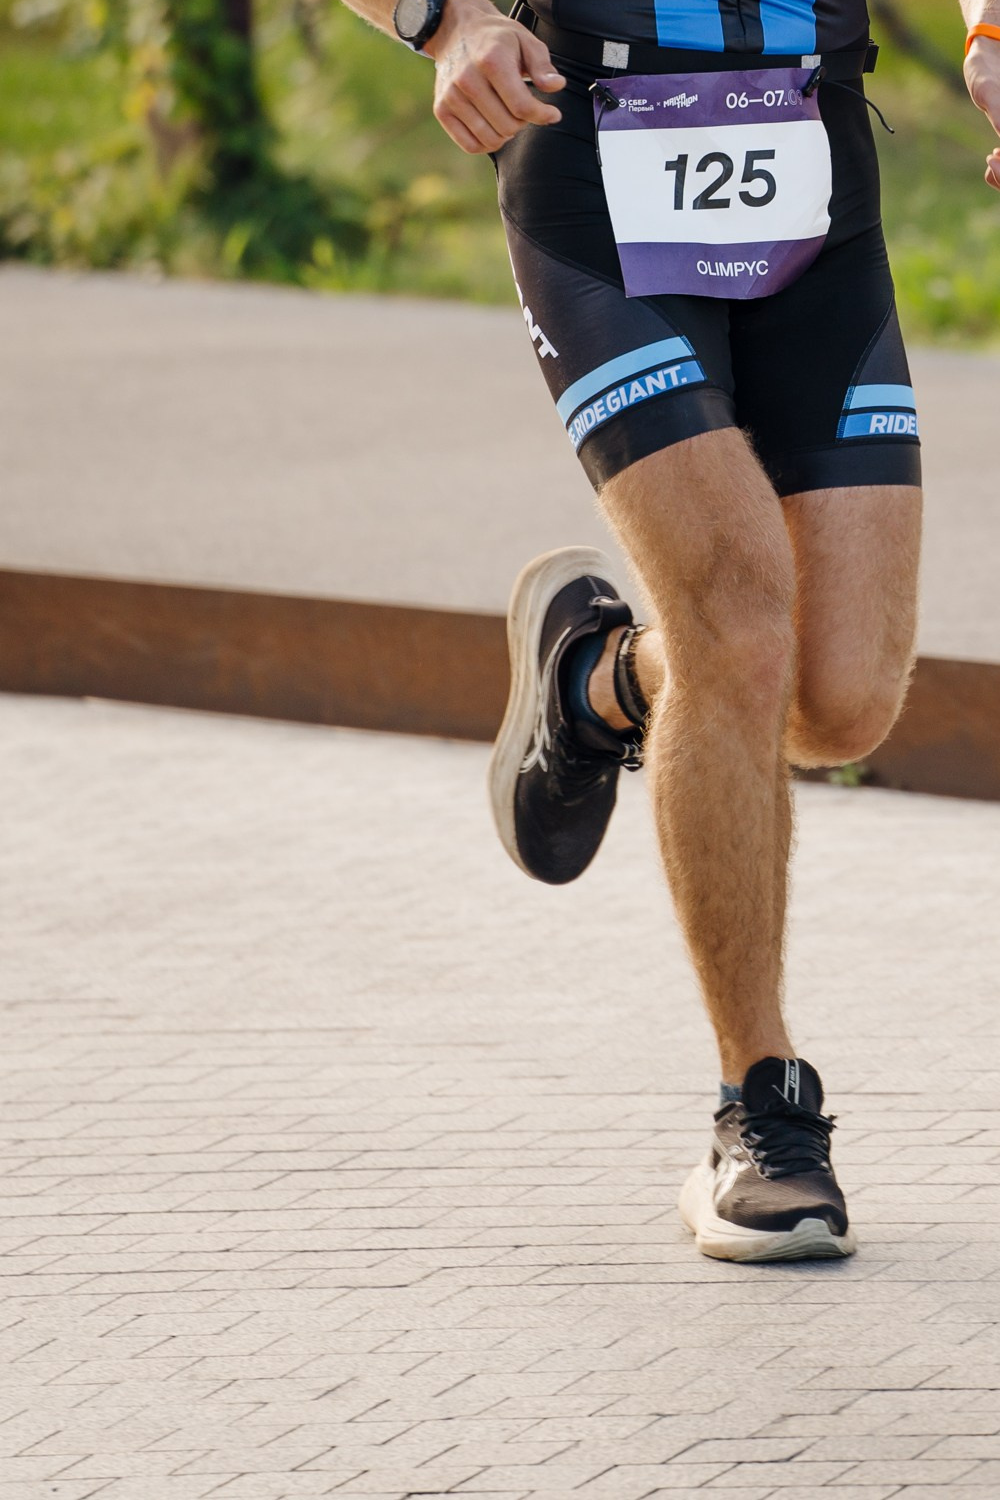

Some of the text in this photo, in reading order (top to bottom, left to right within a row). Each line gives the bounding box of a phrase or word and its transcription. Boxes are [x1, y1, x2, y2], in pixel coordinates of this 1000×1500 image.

[628, 104, 655, 113] Первый
[664, 149, 777, 211] 125
[696, 260, 769, 277] OLIMPYC
[606, 365, 688, 413] GIANT.
[869, 414, 917, 434] RIDE
